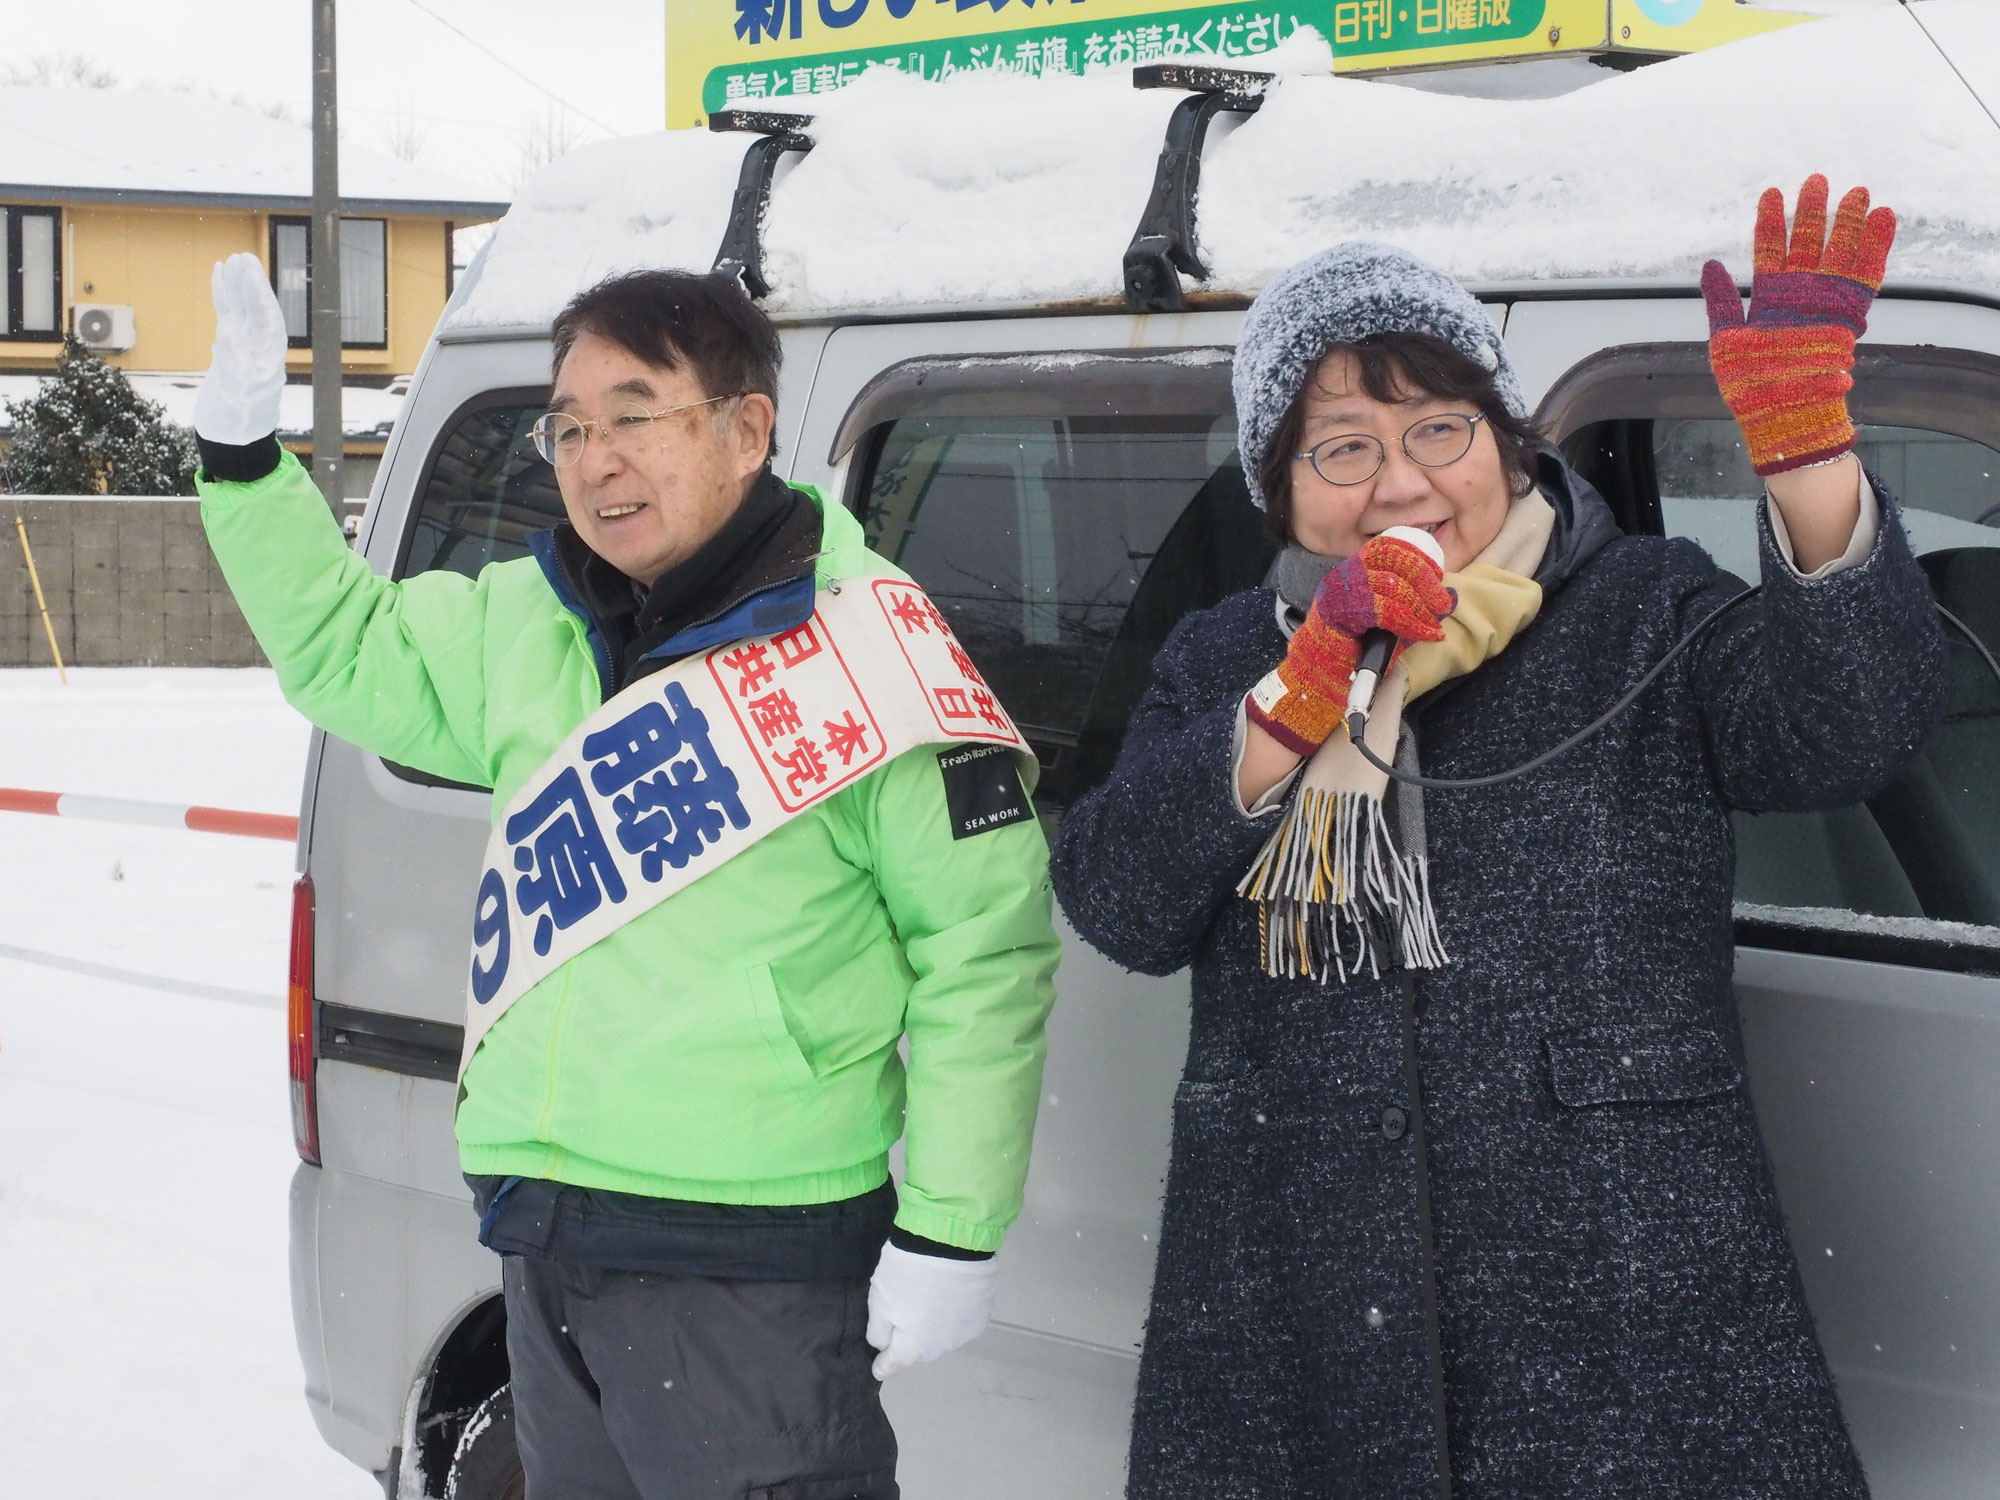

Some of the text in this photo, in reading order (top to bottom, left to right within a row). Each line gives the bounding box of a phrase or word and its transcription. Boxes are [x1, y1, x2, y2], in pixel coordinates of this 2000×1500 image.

[1335, 0, 1511, 43] 日刊・日曜版
[722, 642, 828, 797] 共産党
[965, 807, 1020, 830] SEA WORK
